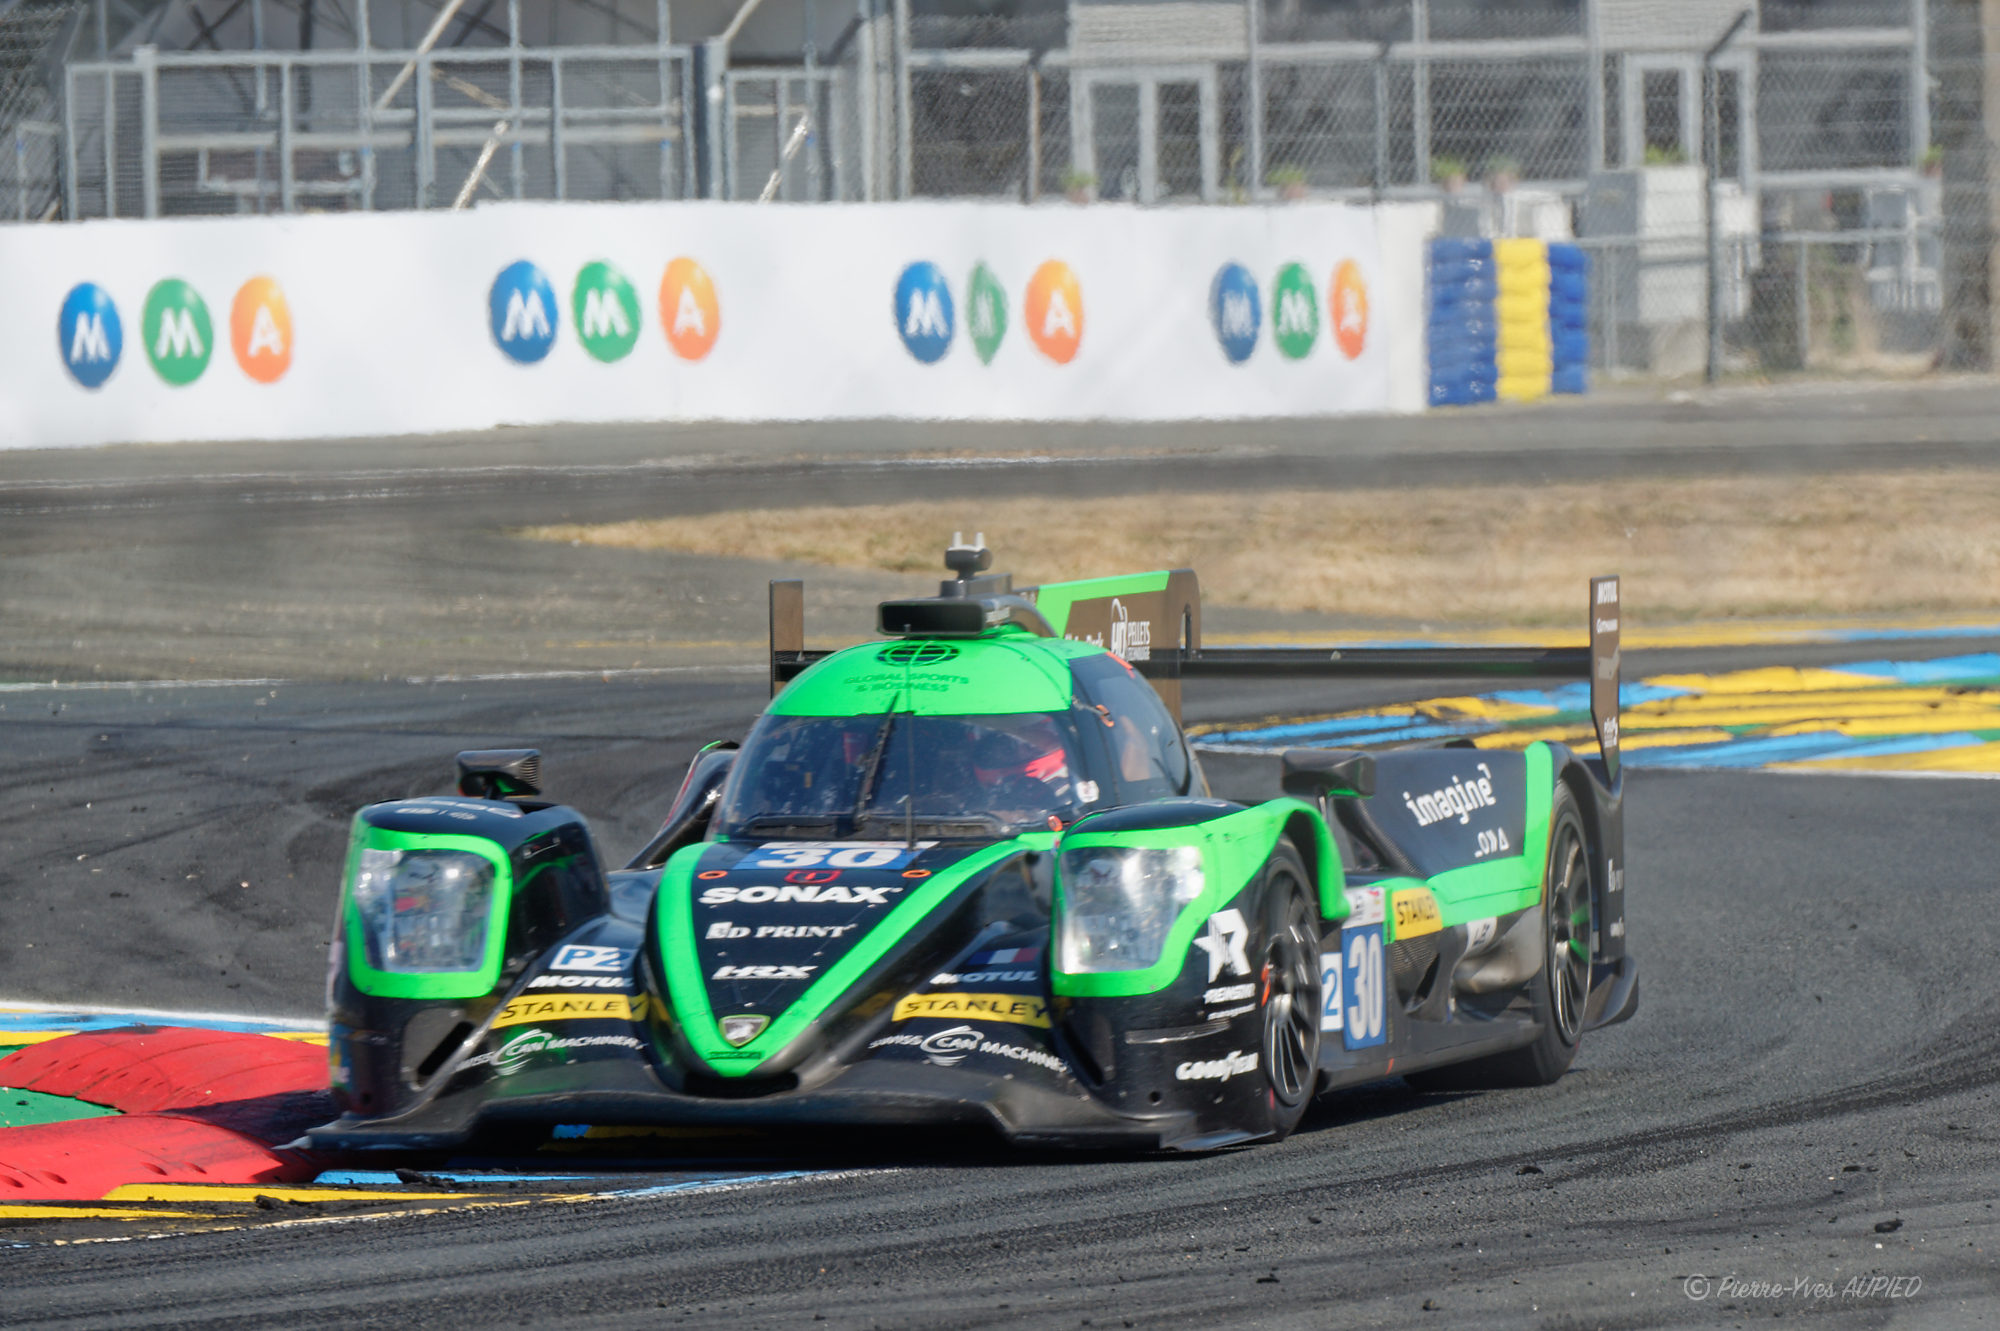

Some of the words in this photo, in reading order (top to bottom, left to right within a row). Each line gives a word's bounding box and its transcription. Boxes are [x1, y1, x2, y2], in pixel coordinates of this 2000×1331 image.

[756, 848, 902, 867] 30
[699, 885, 894, 903] SONAX
[754, 923, 858, 938] PRINT
[560, 949, 631, 968] P2
[526, 975, 635, 988] MOTUL
[929, 970, 1038, 985] MOTUL
[1350, 933, 1384, 1041] 30
[501, 1000, 643, 1019] STANLEY
[903, 1000, 1049, 1019] STANLEY
